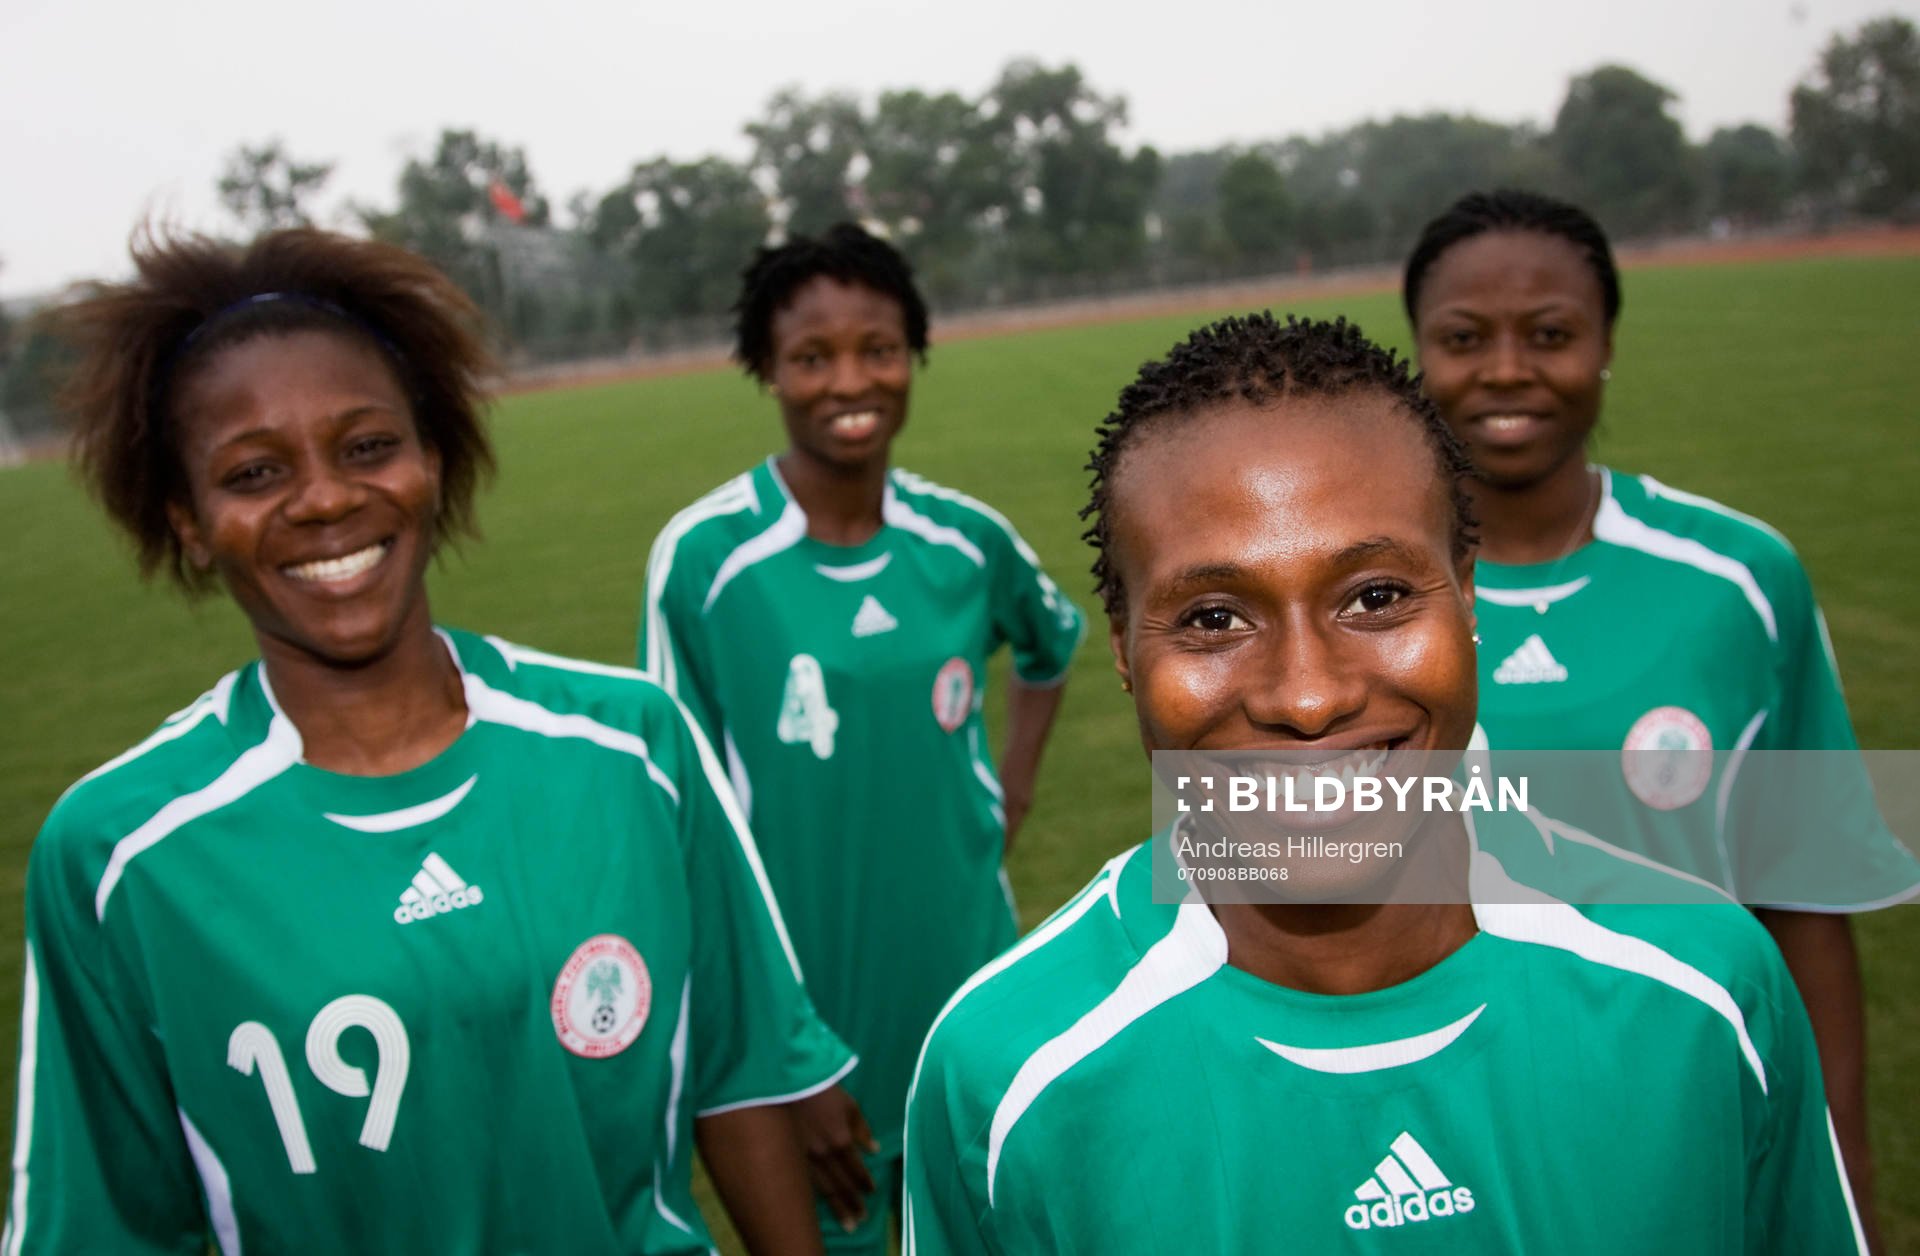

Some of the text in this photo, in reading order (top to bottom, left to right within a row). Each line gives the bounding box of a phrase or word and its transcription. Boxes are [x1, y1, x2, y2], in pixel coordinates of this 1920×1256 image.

[777, 653, 839, 760] 4
[393, 885, 484, 924] adidas
[227, 993, 410, 1174] 19
[1344, 1187, 1476, 1229] adidas
